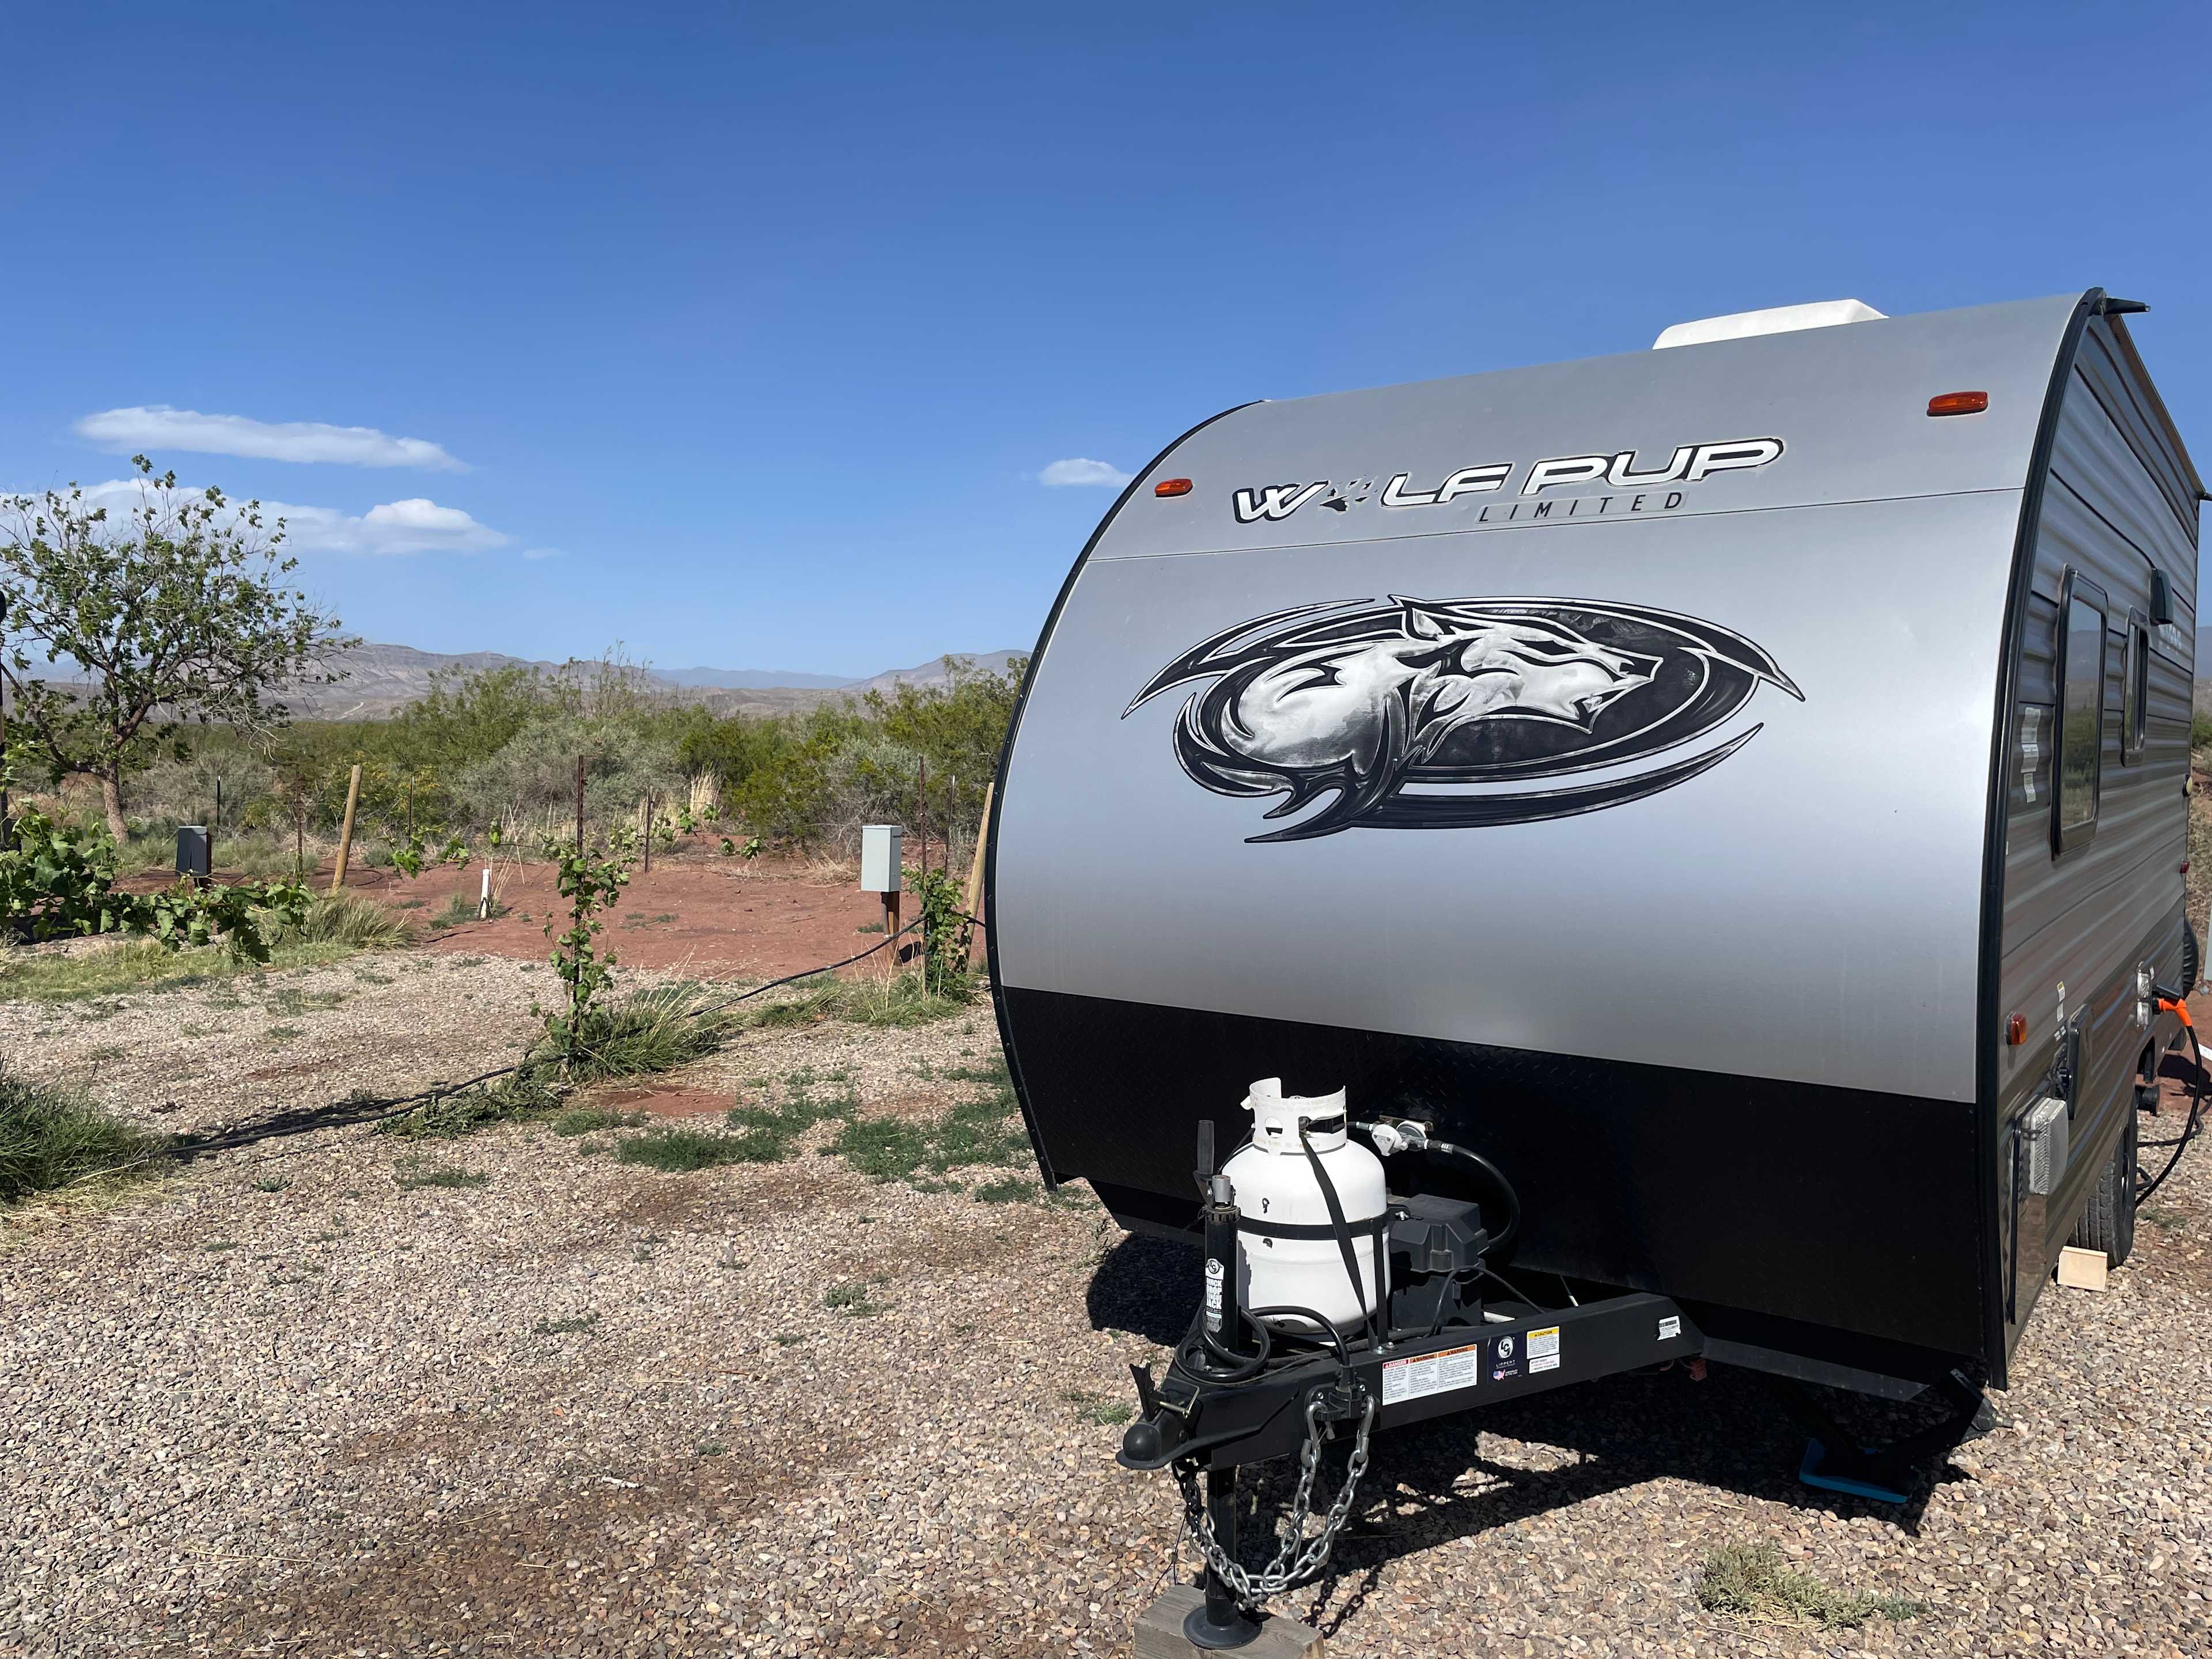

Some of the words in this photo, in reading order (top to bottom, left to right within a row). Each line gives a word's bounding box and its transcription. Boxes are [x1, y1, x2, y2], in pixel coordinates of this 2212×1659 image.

[1520, 438, 1784, 495] PUP
[1479, 492, 1683, 522] LIMITED
[1450, 1347, 1468, 1355] WARNING
[1389, 1359, 1407, 1368] DANGER
